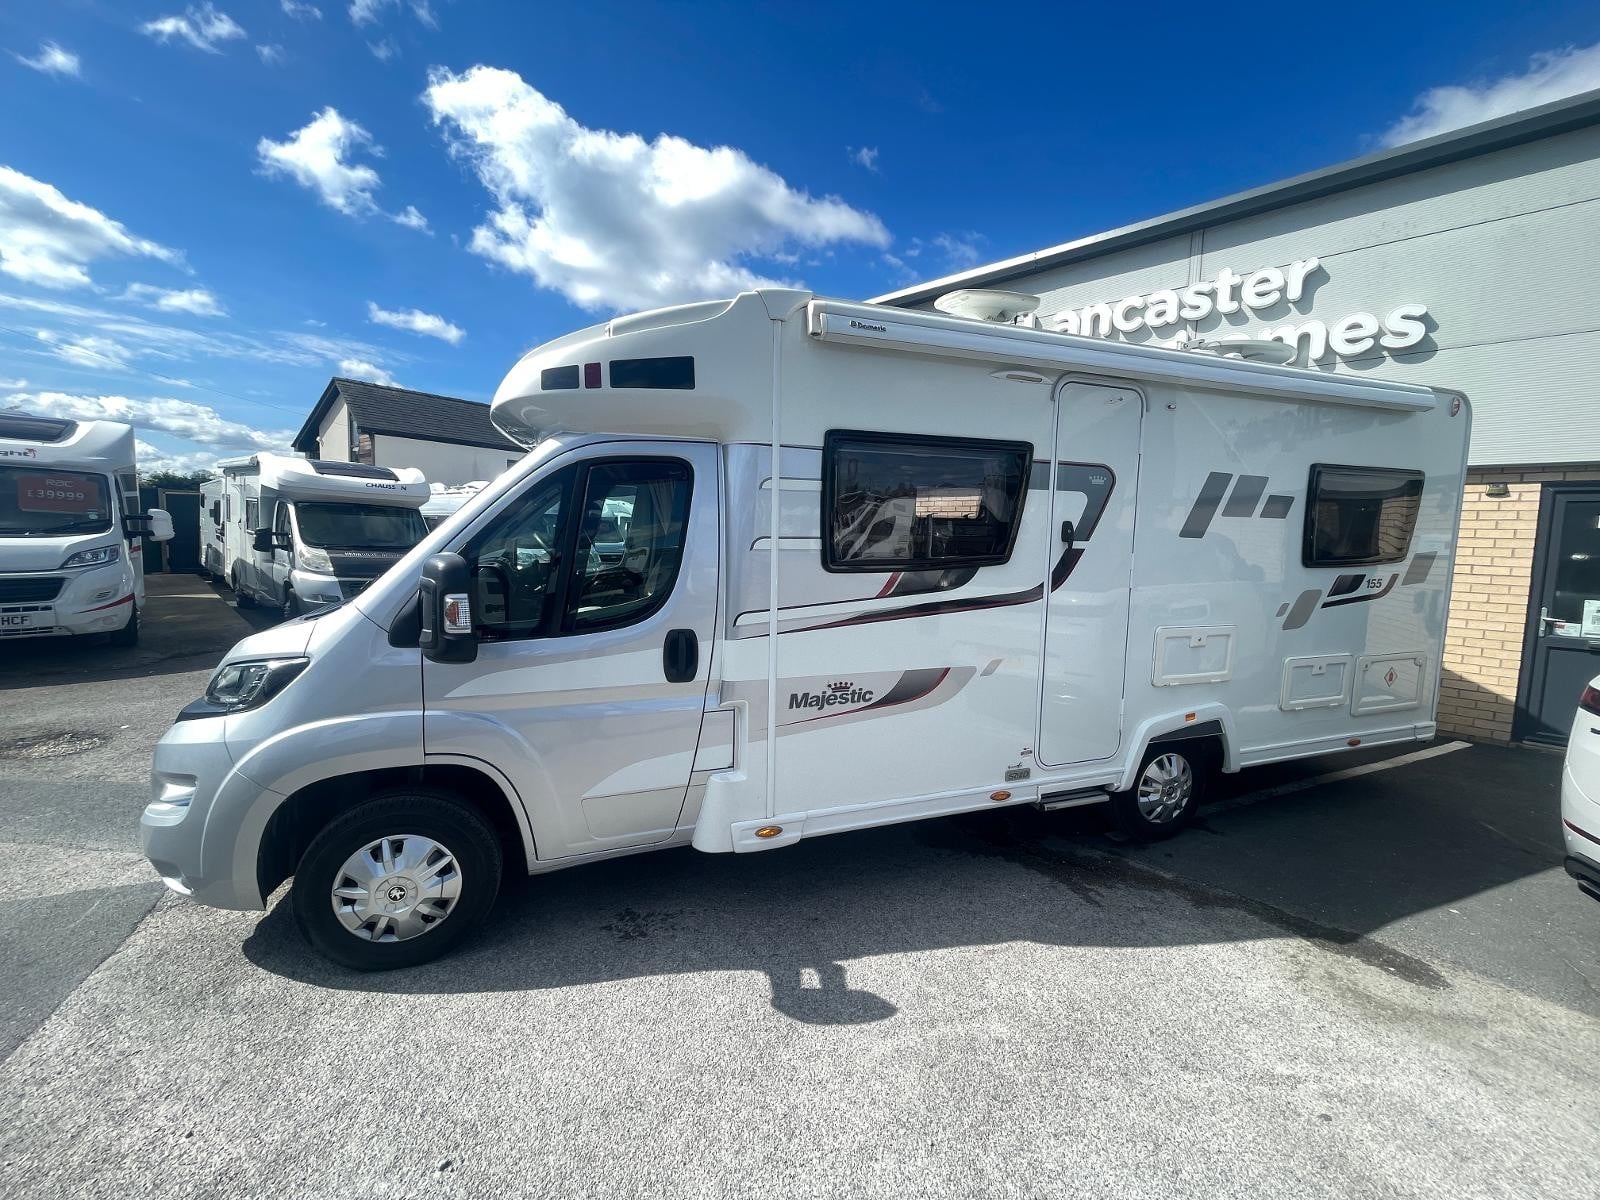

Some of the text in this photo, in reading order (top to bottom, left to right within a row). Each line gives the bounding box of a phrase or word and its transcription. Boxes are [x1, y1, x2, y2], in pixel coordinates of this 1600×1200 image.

[1022, 257, 1321, 338] ancaster
[365, 482, 407, 491] CHAUSSN
[1366, 578, 1383, 589] 155
[1, 615, 29, 626] HCF
[788, 687, 874, 711] Majestic
